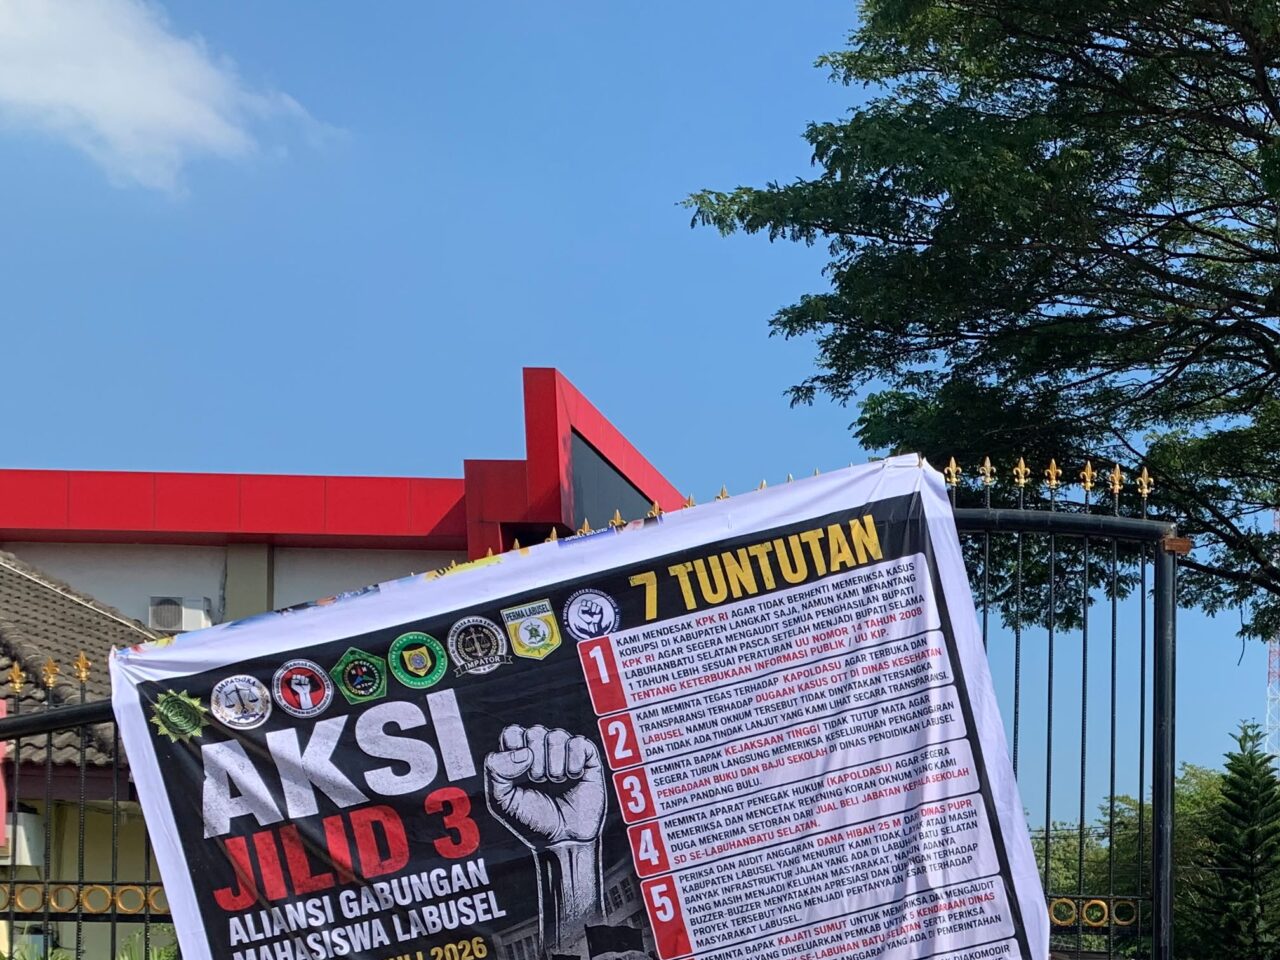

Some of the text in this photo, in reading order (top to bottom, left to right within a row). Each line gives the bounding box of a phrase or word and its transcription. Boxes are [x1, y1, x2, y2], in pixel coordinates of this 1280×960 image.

[628, 571, 658, 620] 7
[668, 514, 883, 610] TUNTUTAN
[525, 604, 550, 618] LABUSEL
[615, 562, 915, 647] KAMI MENDESAK KPK RI AGAR TIDAK BERHENTI MEMERIKSA KASUS
[618, 573, 916, 658] KORUPSI DI KABUPATEN LANGKAT SAJA, NAMUN KAMI MENANTANG
[621, 585, 914, 668] KPK RI AGAR SEGERA MENGAUDIT SEMUA PENGHASILAN BUPATI
[624, 594, 924, 679] LABUHANBATU SELATAN PASCA SETELAH MENJADI BUPATI SELAMA
[465, 655, 501, 670] IMPATOR
[589, 645, 610, 684] 1
[628, 606, 922, 690] 1 TAHUN LEBIH SESUAI PERATURAN UU NOMOR 14 TAHUN 2008
[630, 683, 677, 701] TENTANG
[679, 664, 752, 690] KETERBUKAAN
[754, 649, 808, 671] INFORMASI
[810, 639, 845, 656] PUBLIK
[854, 632, 867, 643] UU
[870, 628, 888, 639] KIP.
[635, 637, 927, 721] KAMI MEMINTA TEGAS TERHADAP KAPOLDASU AGAR TERBUKA DAN
[638, 647, 942, 733] TRANSPARANSI TERHADAP DUGAAN KASUS OTT DI DINAS KESEHATAN
[202, 688, 477, 838] AKSI
[608, 721, 632, 759] 2
[650, 694, 930, 775] MEMINTA BAPAK KEJAKSAAN TINGGI TIDAK TUTUP MATA AGAR
[623, 775, 646, 813] 3
[659, 777, 762, 810] TANPA PANDANG BULU.
[663, 755, 919, 829] MEMINTA APARAT PENEGAK HUKUM (KAPOLDASU) AGAR
[214, 786, 480, 911] JILID 3
[639, 828, 659, 865] 4
[673, 819, 820, 864] SD SE-LABUHANBATU SELATAN.
[678, 818, 901, 883] PERIKSA DAN AUDIT ANGGARAN DANA HIBAH 25 M
[229, 858, 490, 946] ALIANSI GABUNGAN
[392, 890, 506, 942] LABUSEL
[650, 884, 674, 922] 5
[695, 914, 802, 948] MASYARAKAT LABUSEL.
[744, 939, 776, 954] BAPAK
[777, 929, 811, 946] KAJATI
[813, 919, 846, 935] SUMUT
[849, 911, 880, 926] UNTUK
